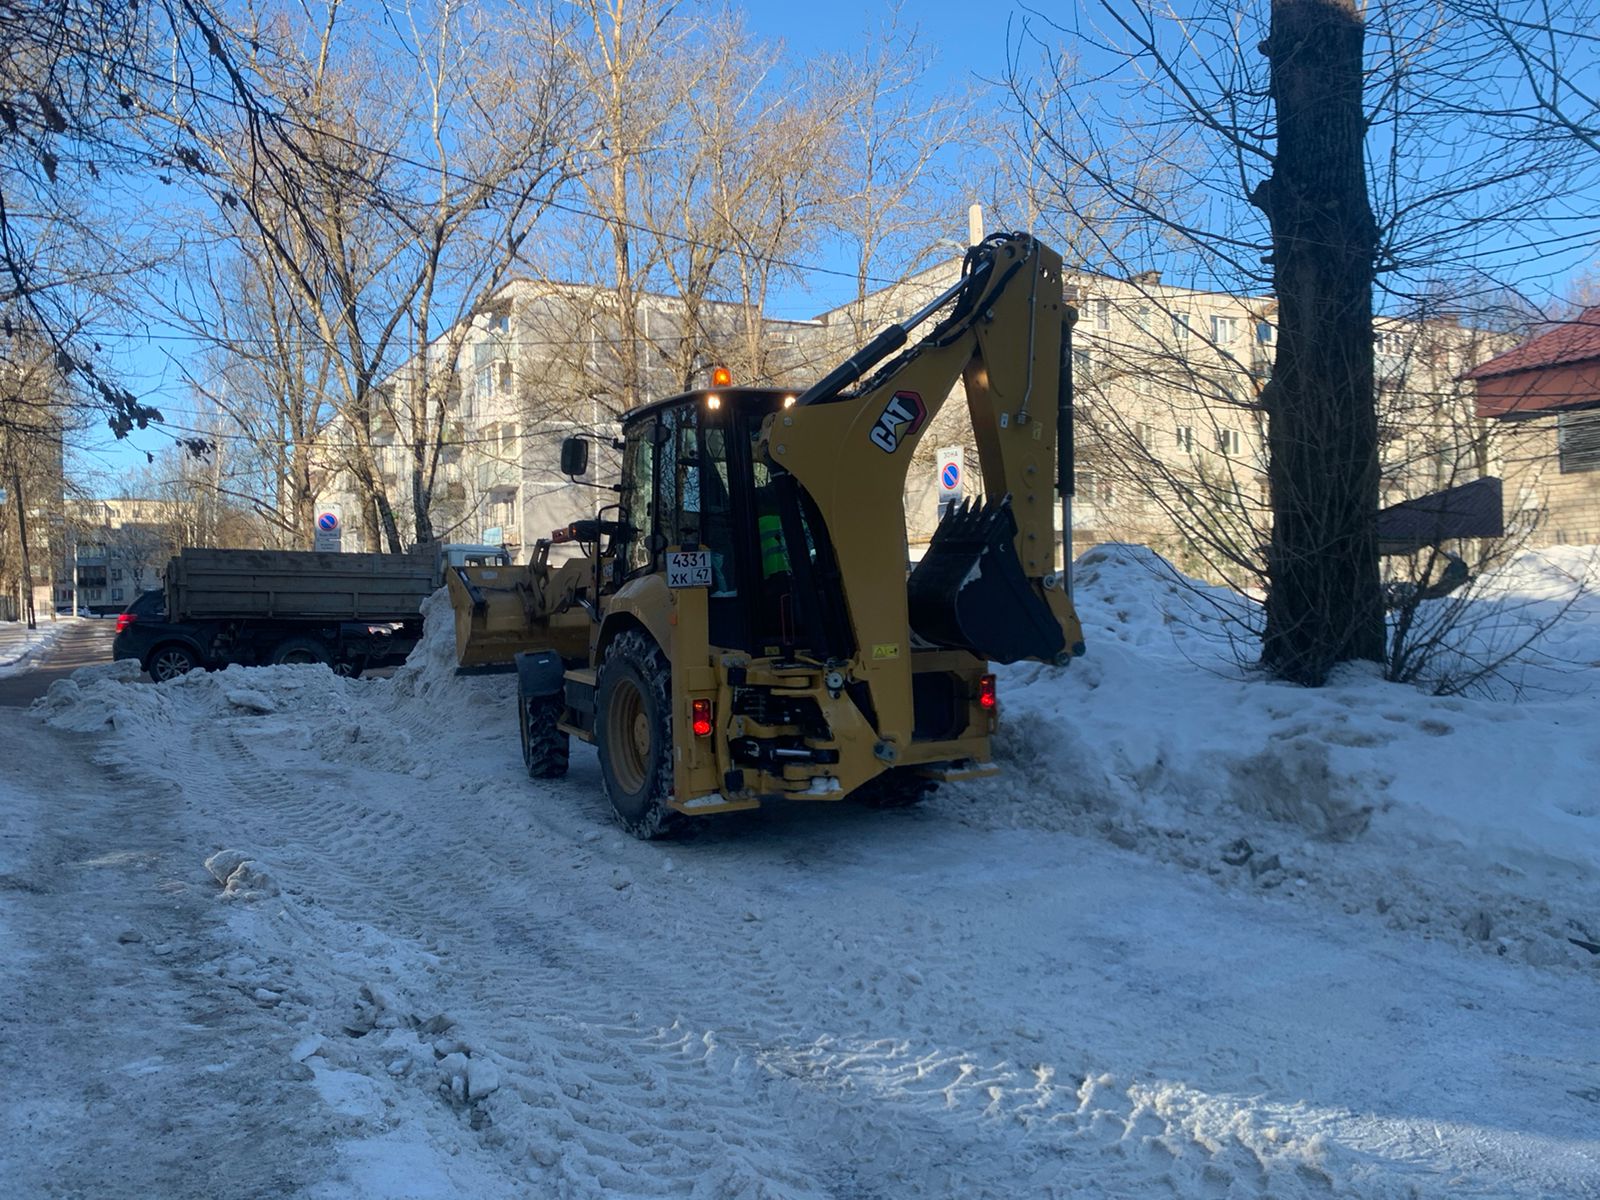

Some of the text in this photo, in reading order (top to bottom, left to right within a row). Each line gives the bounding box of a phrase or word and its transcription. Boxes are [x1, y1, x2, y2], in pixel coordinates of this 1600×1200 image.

[870, 396, 915, 452] CAT
[673, 553, 706, 567] 4331
[696, 569, 708, 579] 47
